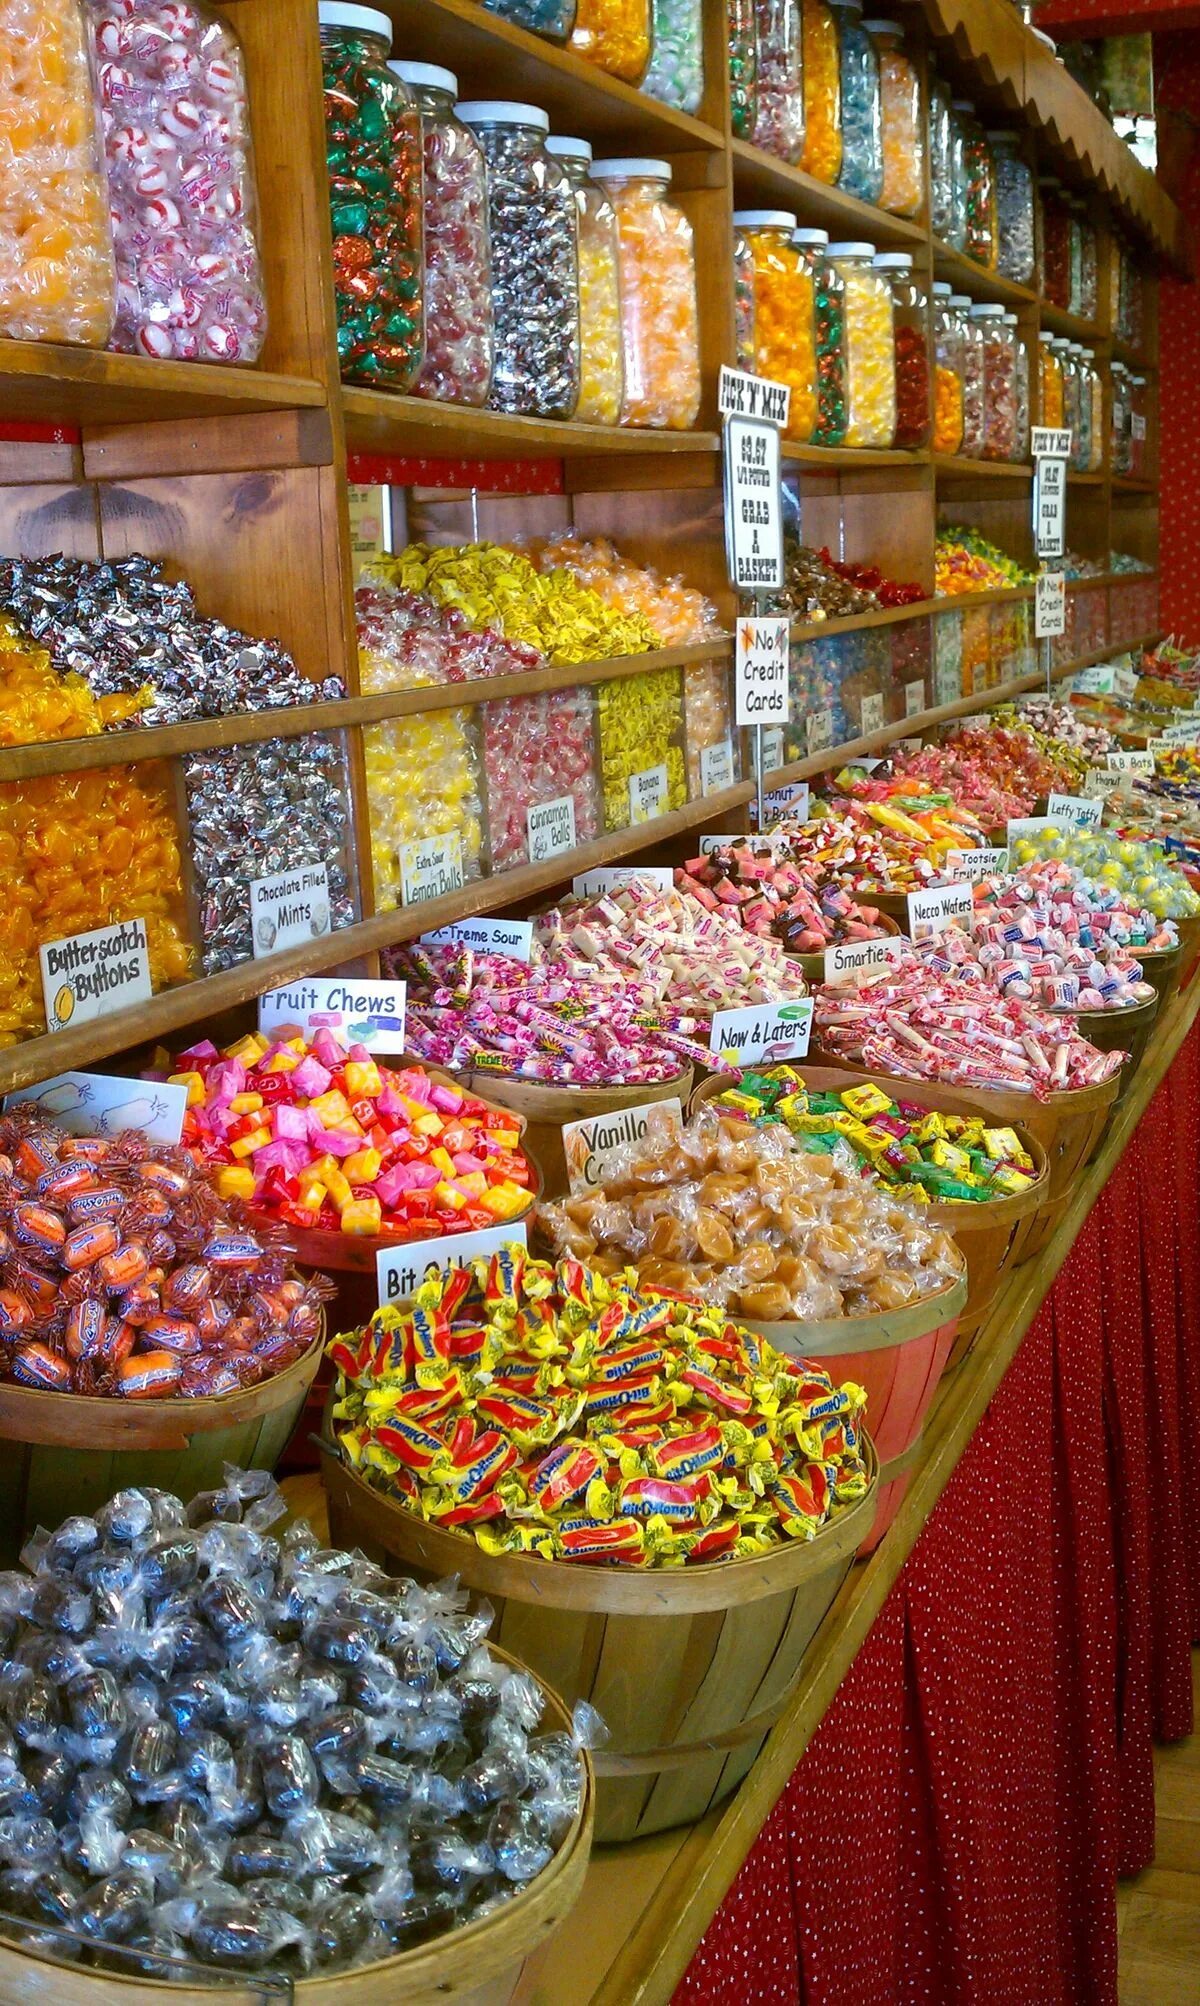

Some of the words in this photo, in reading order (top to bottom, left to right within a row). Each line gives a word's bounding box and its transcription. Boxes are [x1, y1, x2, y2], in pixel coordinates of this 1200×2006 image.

[762, 386, 787, 420] MIX
[742, 499, 769, 525] GRAB
[752, 529, 760, 554] A
[738, 557, 777, 582] BASKET
[1046, 580, 1057, 592] No
[1040, 599, 1062, 611] Credit
[1041, 616, 1062, 629] Cards
[755, 629, 774, 650] No
[744, 660, 785, 681] Credit
[746, 690, 783, 712] Cards
[1131, 757, 1152, 769] Bats
[638, 775, 659, 793] Banana
[1051, 803, 1074, 819] Laffy
[1077, 807, 1098, 823] Taffy
[551, 824, 570, 847] Balls
[416, 854, 432, 870] Extra
[431, 851, 444, 866] Sour
[961, 853, 997, 864] Tootsie
[405, 879, 438, 905] Lemon
[439, 867, 461, 897] Balls
[980, 867, 1003, 882] Roll
[257, 881, 302, 903] Chocolate
[302, 874, 326, 895] Filled
[277, 903, 312, 929] Mints
[914, 902, 940, 921] Necco
[942, 897, 973, 917] Wafers
[492, 929, 523, 945] Sour
[76, 957, 140, 1001] Buttons
[261, 987, 318, 1010] Fruit
[326, 988, 395, 1013] Chews
[719, 1027, 749, 1050] Now
[751, 1022, 761, 1043] &
[763, 1020, 807, 1044] Laters
[580, 1113, 648, 1153] Vanilla
[387, 1267, 416, 1298] Bit
